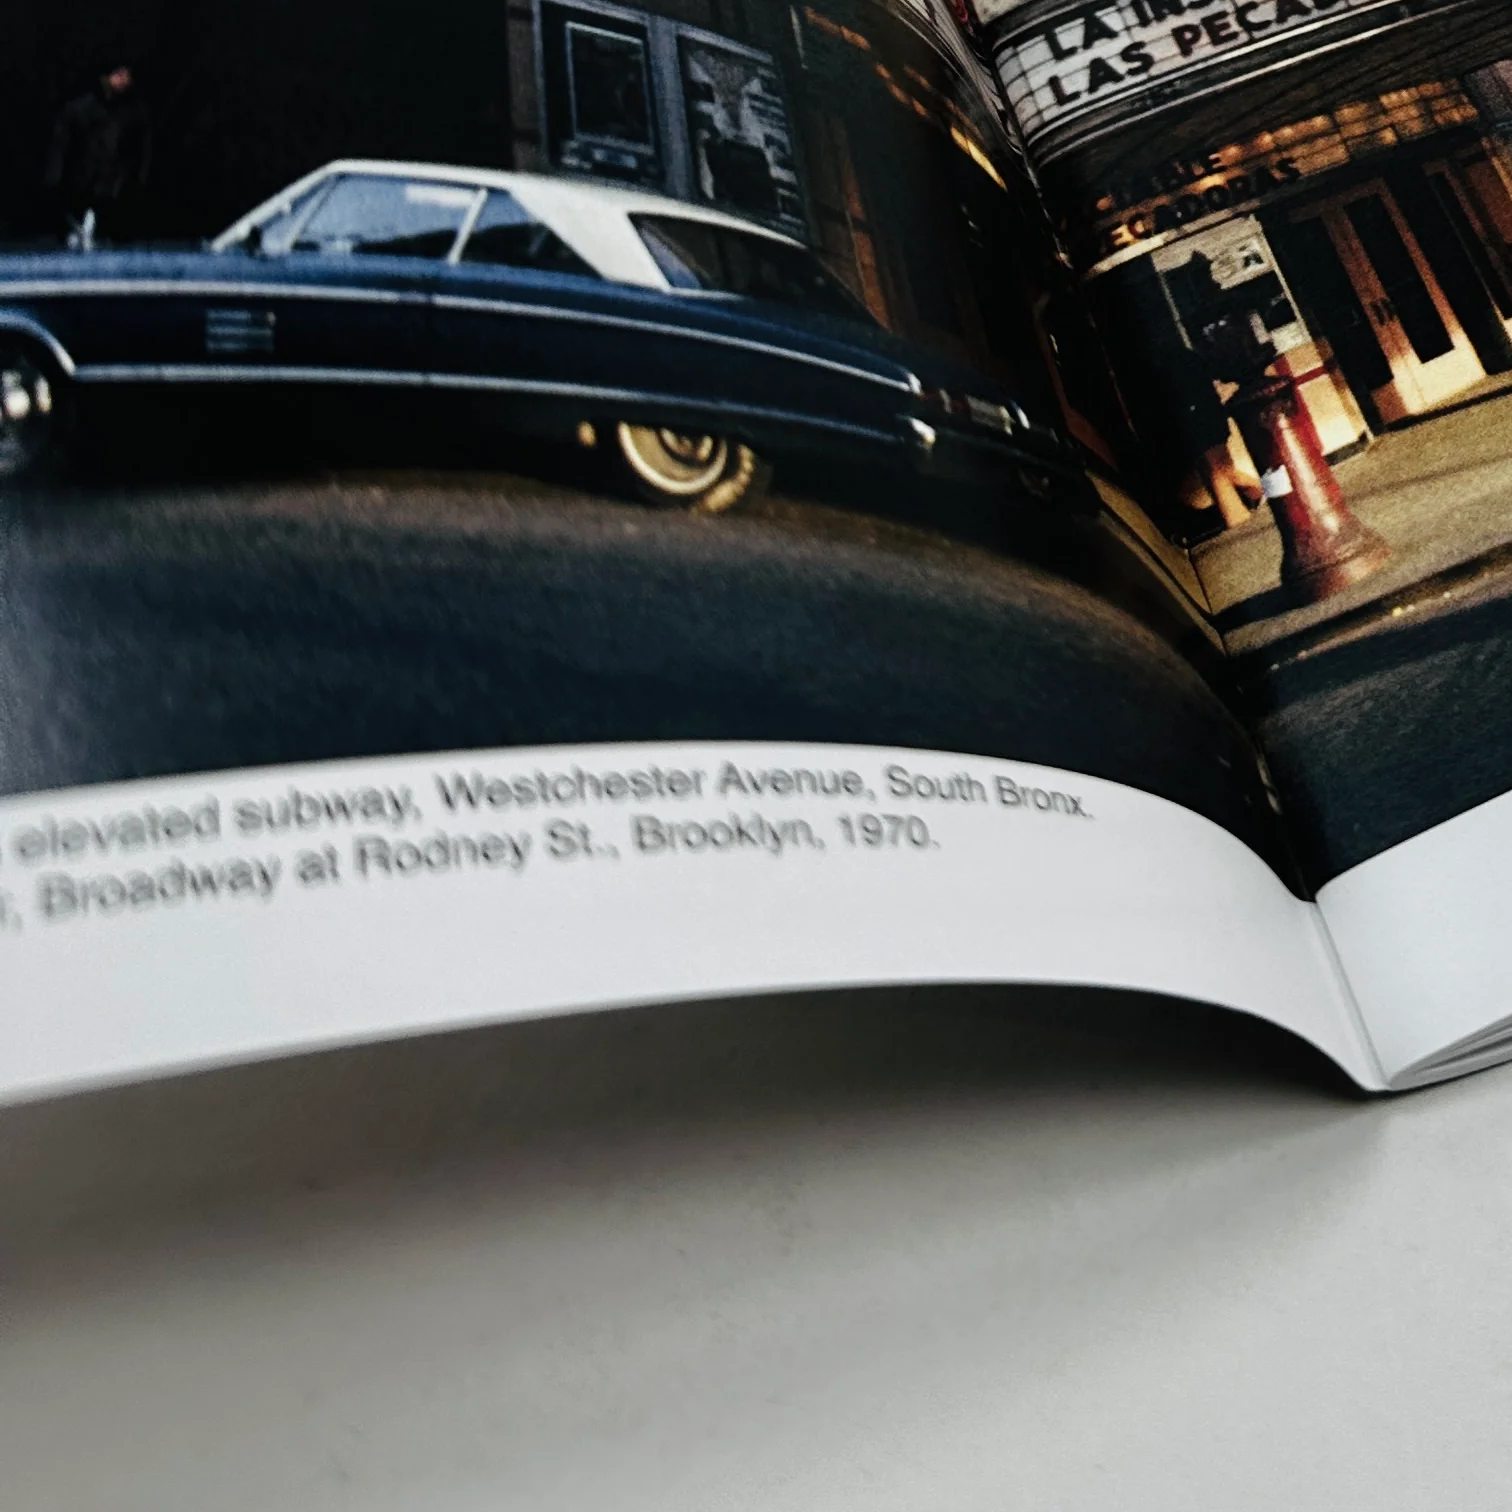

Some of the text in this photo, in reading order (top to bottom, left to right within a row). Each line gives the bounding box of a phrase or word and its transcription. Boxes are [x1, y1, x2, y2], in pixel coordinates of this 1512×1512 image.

[1043, 8, 1120, 62] LA
[1046, 40, 1156, 107] LAS
[11, 759, 1095, 866] elevated subway, Westchester Avenue, South Bronx.
[36, 857, 281, 918] Broadway
[294, 840, 340, 885] at
[352, 827, 532, 877] Rodney
[630, 810, 826, 856] Brooklyn,
[836, 813, 941, 851] 1970.
